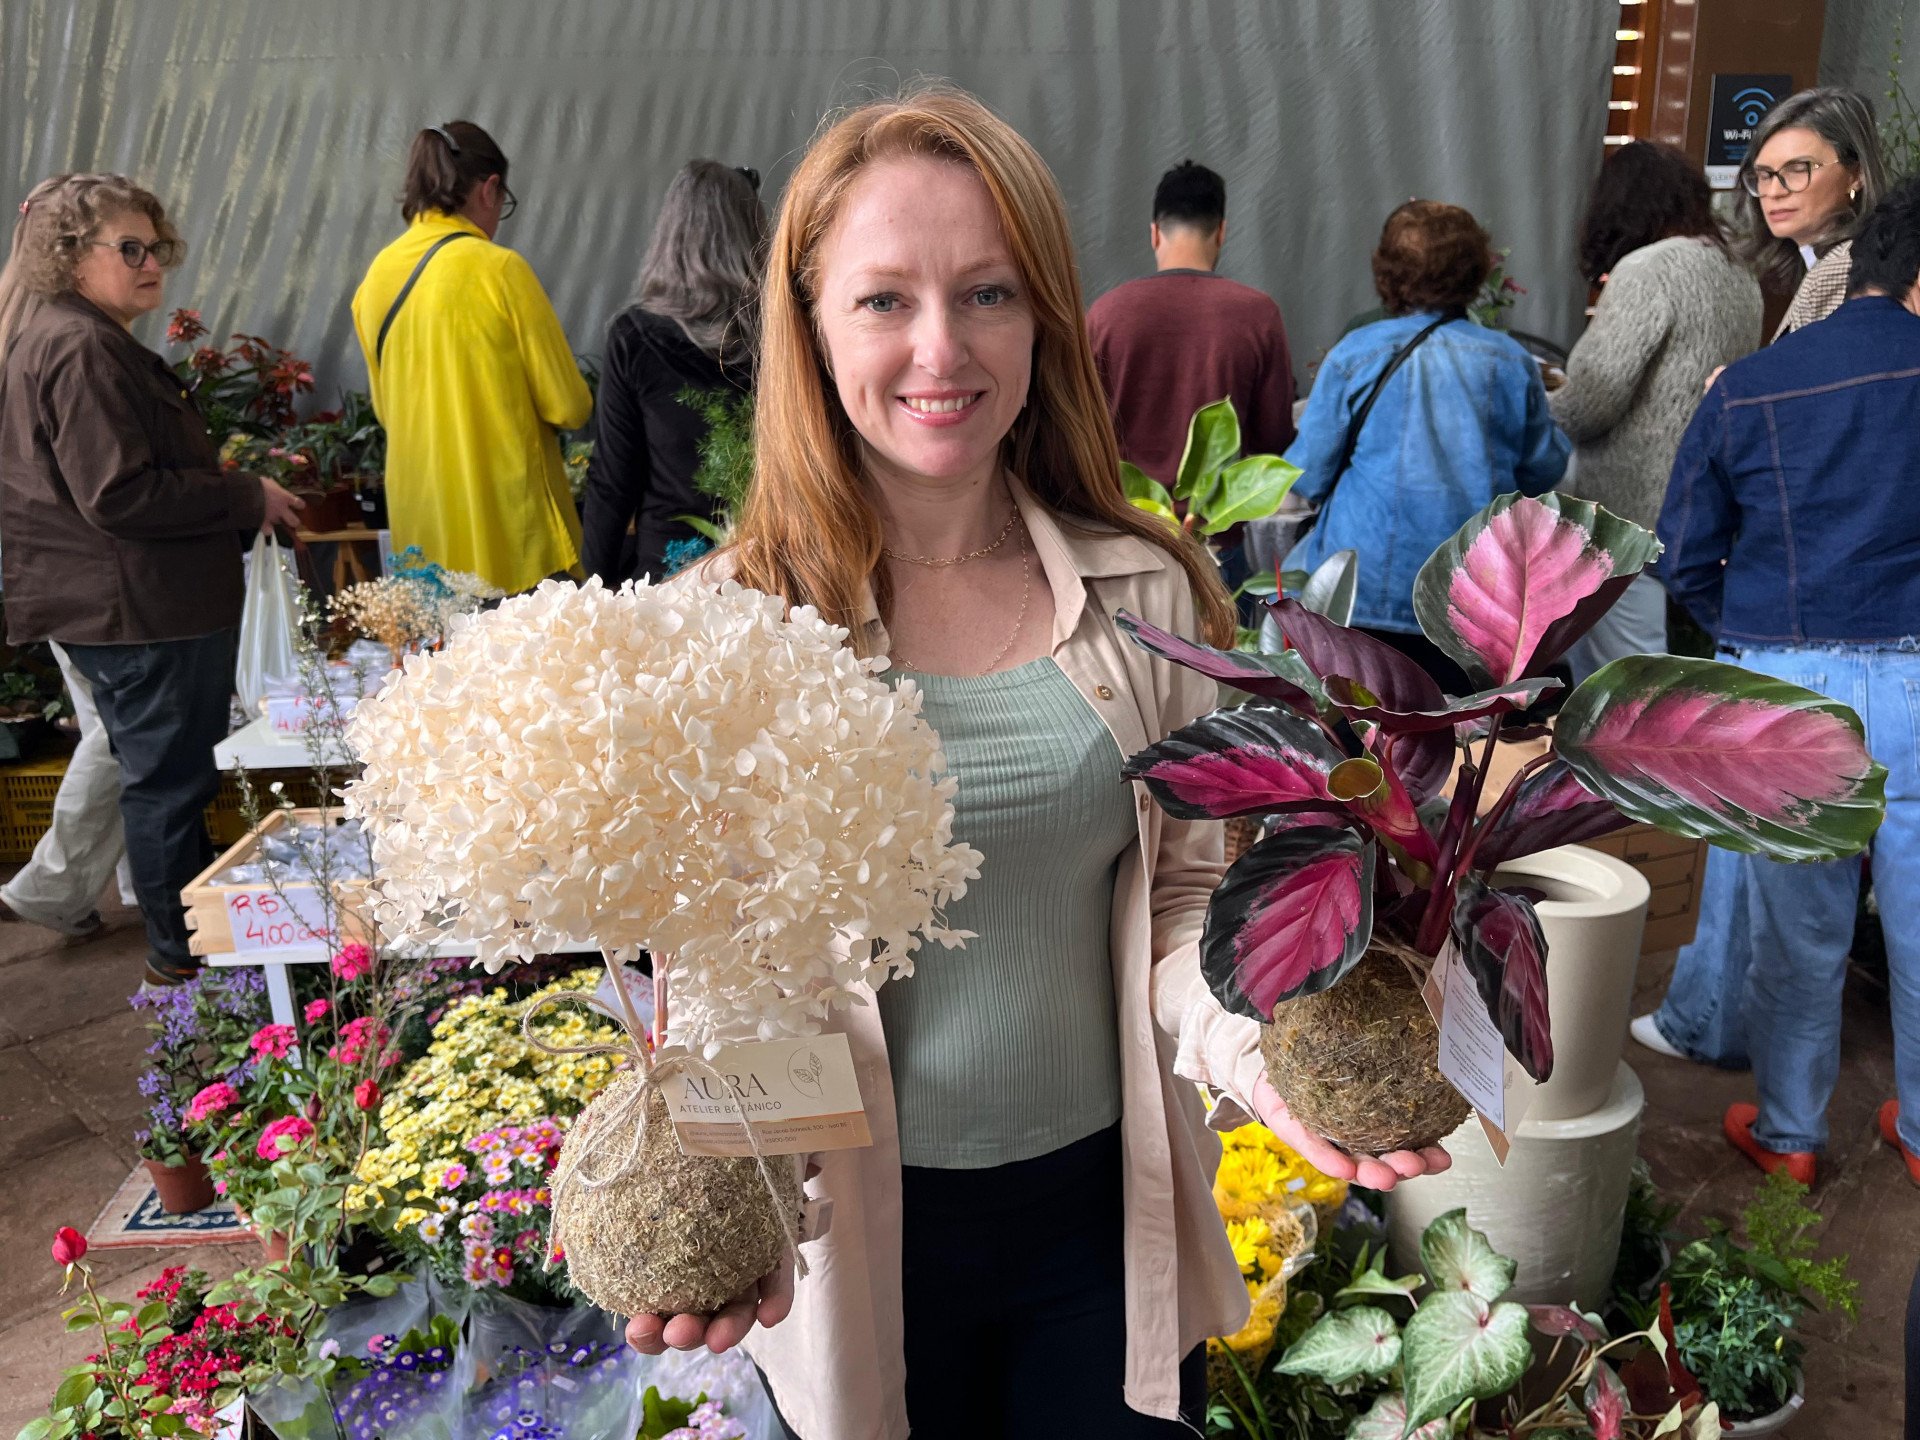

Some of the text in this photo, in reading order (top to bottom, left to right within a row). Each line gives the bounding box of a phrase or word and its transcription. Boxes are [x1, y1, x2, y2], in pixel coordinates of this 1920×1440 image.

[1722, 128, 1752, 140] Wi-Fi
[231, 894, 279, 917] R$
[246, 919, 294, 947] 4,00
[684, 1072, 768, 1100] AURA
[679, 1104, 721, 1114] ATELIER
